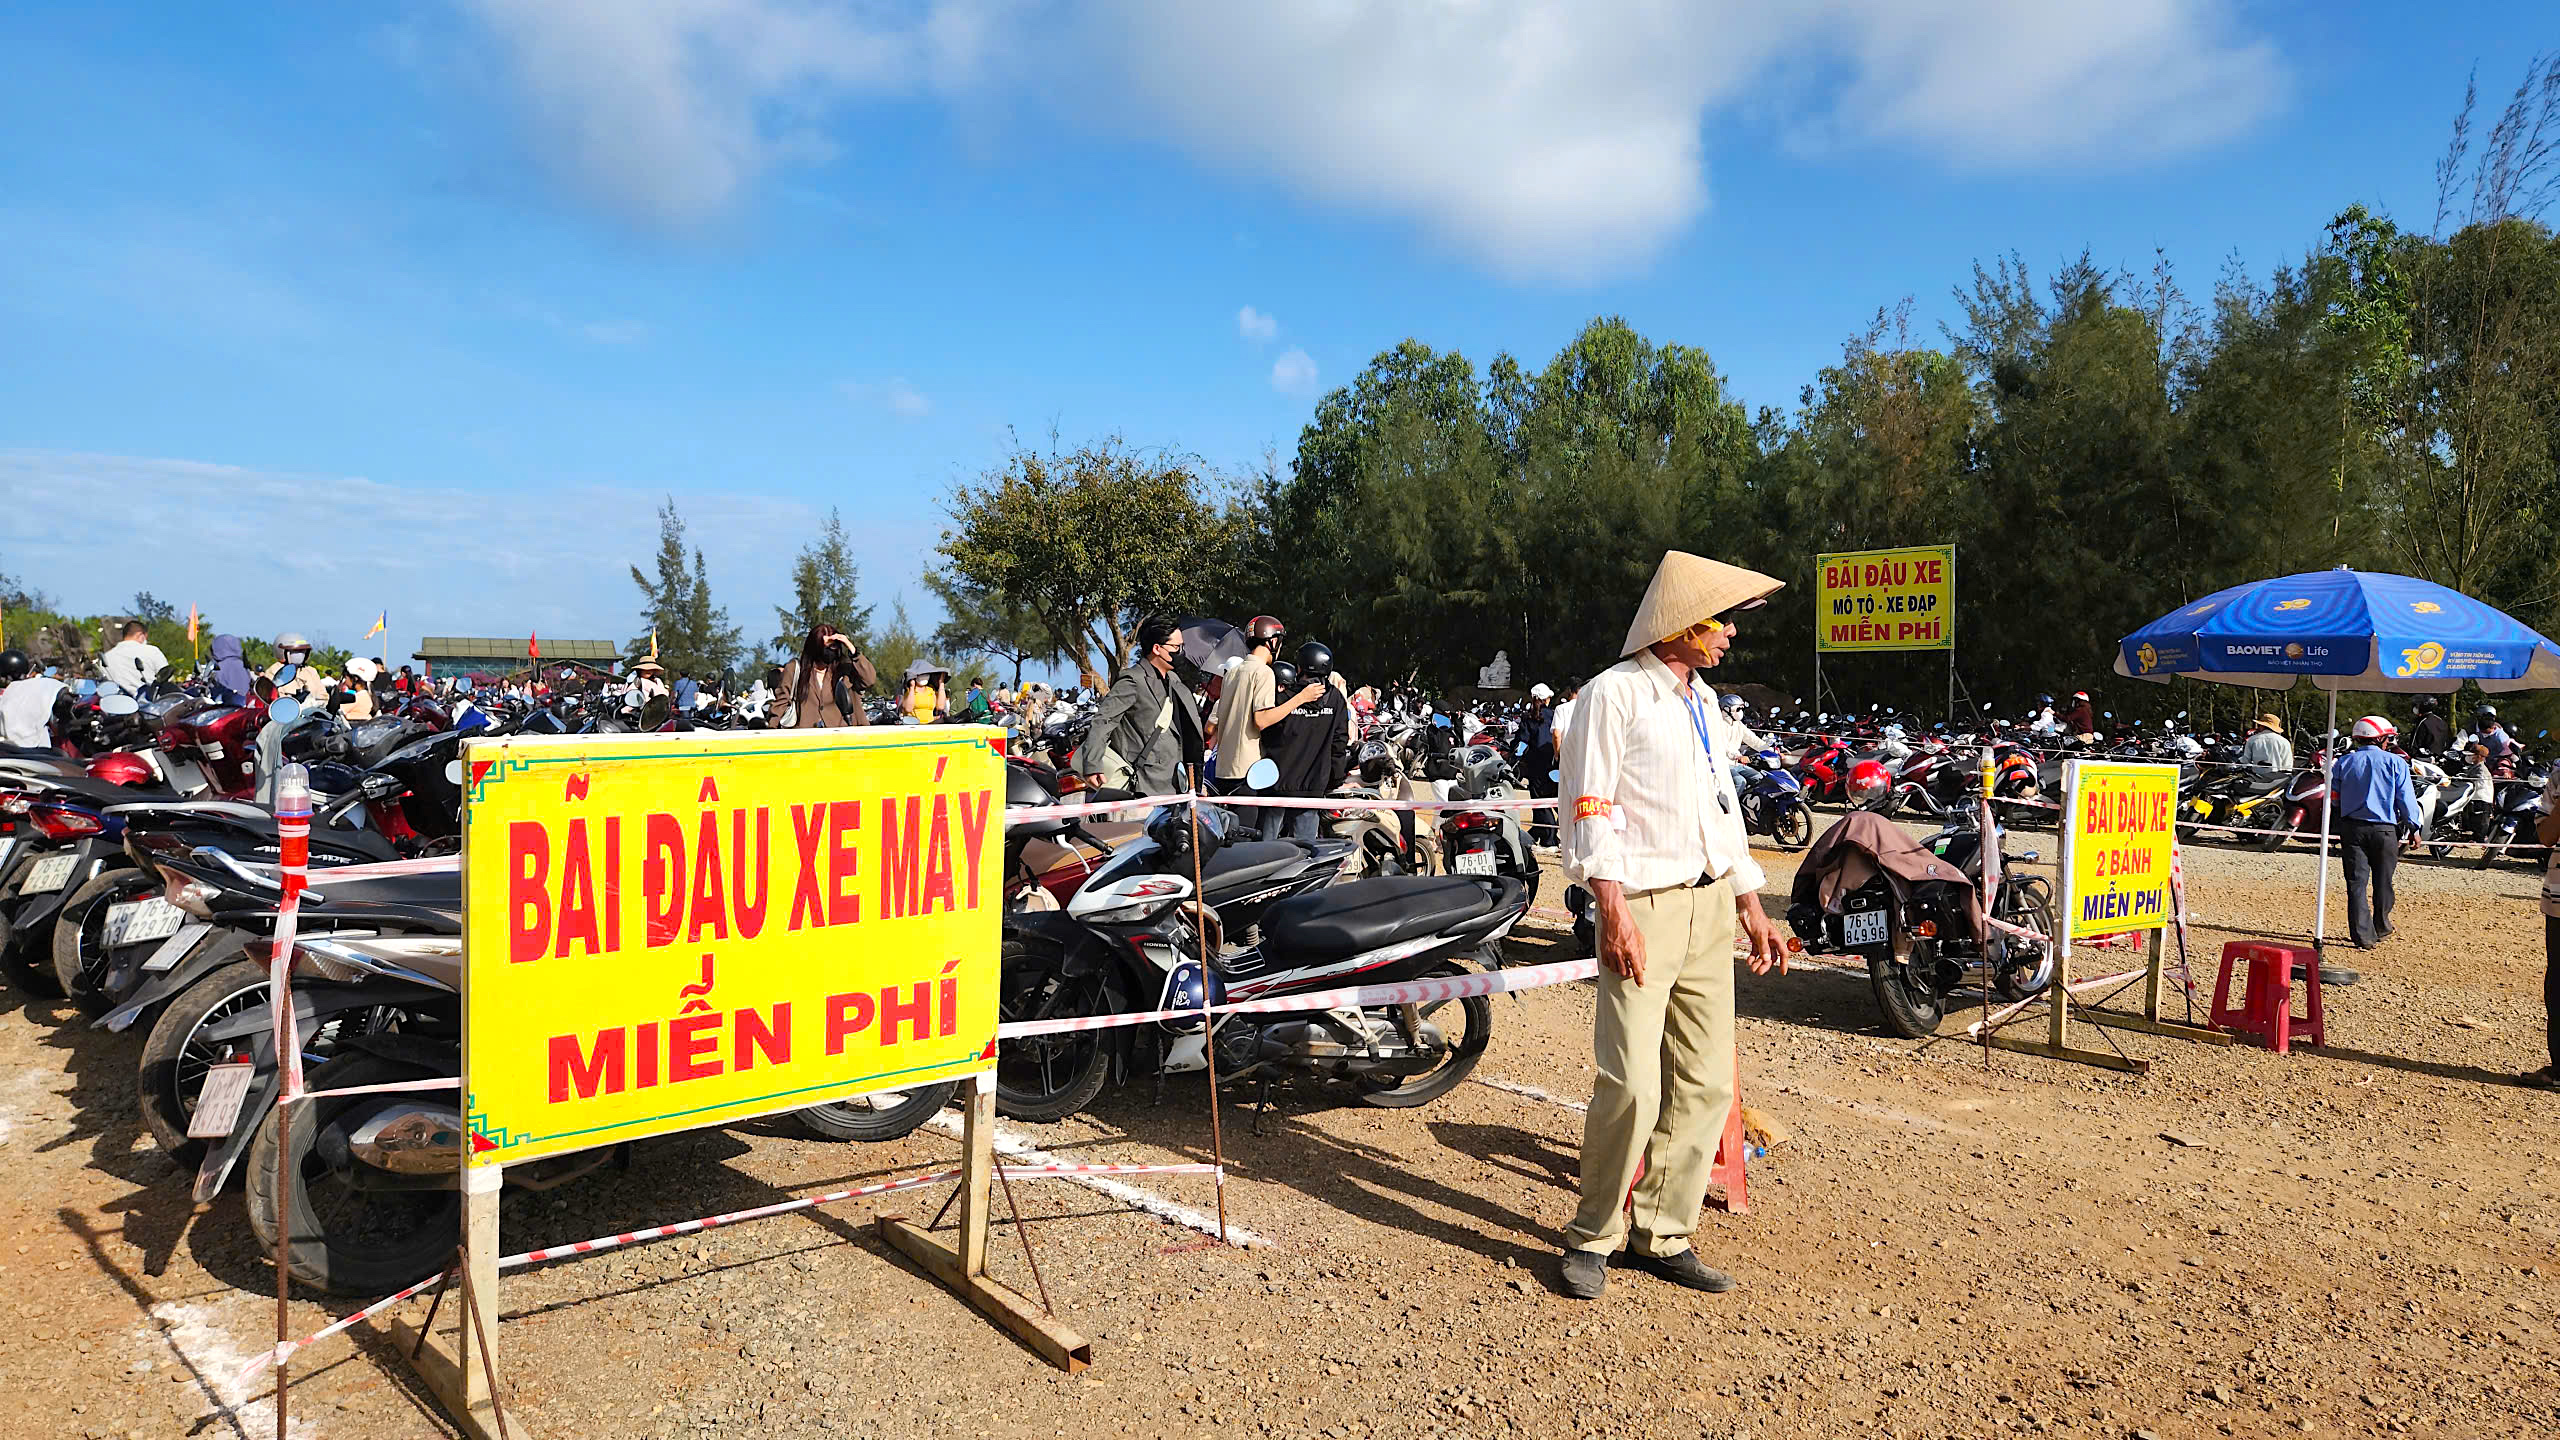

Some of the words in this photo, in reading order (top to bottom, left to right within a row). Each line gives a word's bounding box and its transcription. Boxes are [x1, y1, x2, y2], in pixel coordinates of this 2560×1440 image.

[1827, 560, 1858, 588] BÃI
[1865, 558, 1907, 592] ĐẬU
[1914, 560, 1941, 584] XE
[1833, 595, 1852, 615] MÔ
[1857, 593, 1874, 614] TÔ
[1886, 596, 1904, 613] XE
[1908, 595, 1936, 616] ĐẠP
[1832, 616, 1890, 642] MIỄN
[1898, 616, 1940, 640] PHÍ
[2226, 645, 2282, 655] BAOVIET
[2307, 646, 2329, 656] Life
[2396, 641, 2446, 676] 30
[2087, 778, 2113, 834] BÃI
[2118, 781, 2147, 841] ĐẬU
[2150, 792, 2168, 832] XE
[509, 773, 621, 964] BÃI
[788, 800, 861, 931] XE
[880, 757, 992, 919] MÁY
[2096, 850, 2105, 876] 2
[2110, 841, 2151, 876] BÁNH
[114, 906, 136, 925] 76-
[2083, 881, 2130, 921] MIỄN
[2134, 882, 2162, 915] PHÍ
[1846, 927, 1885, 943] 849.96
[1849, 912, 1879, 928] 76-C1
[549, 984, 792, 1104] MIỄN
[825, 959, 961, 1056] PHÍ
